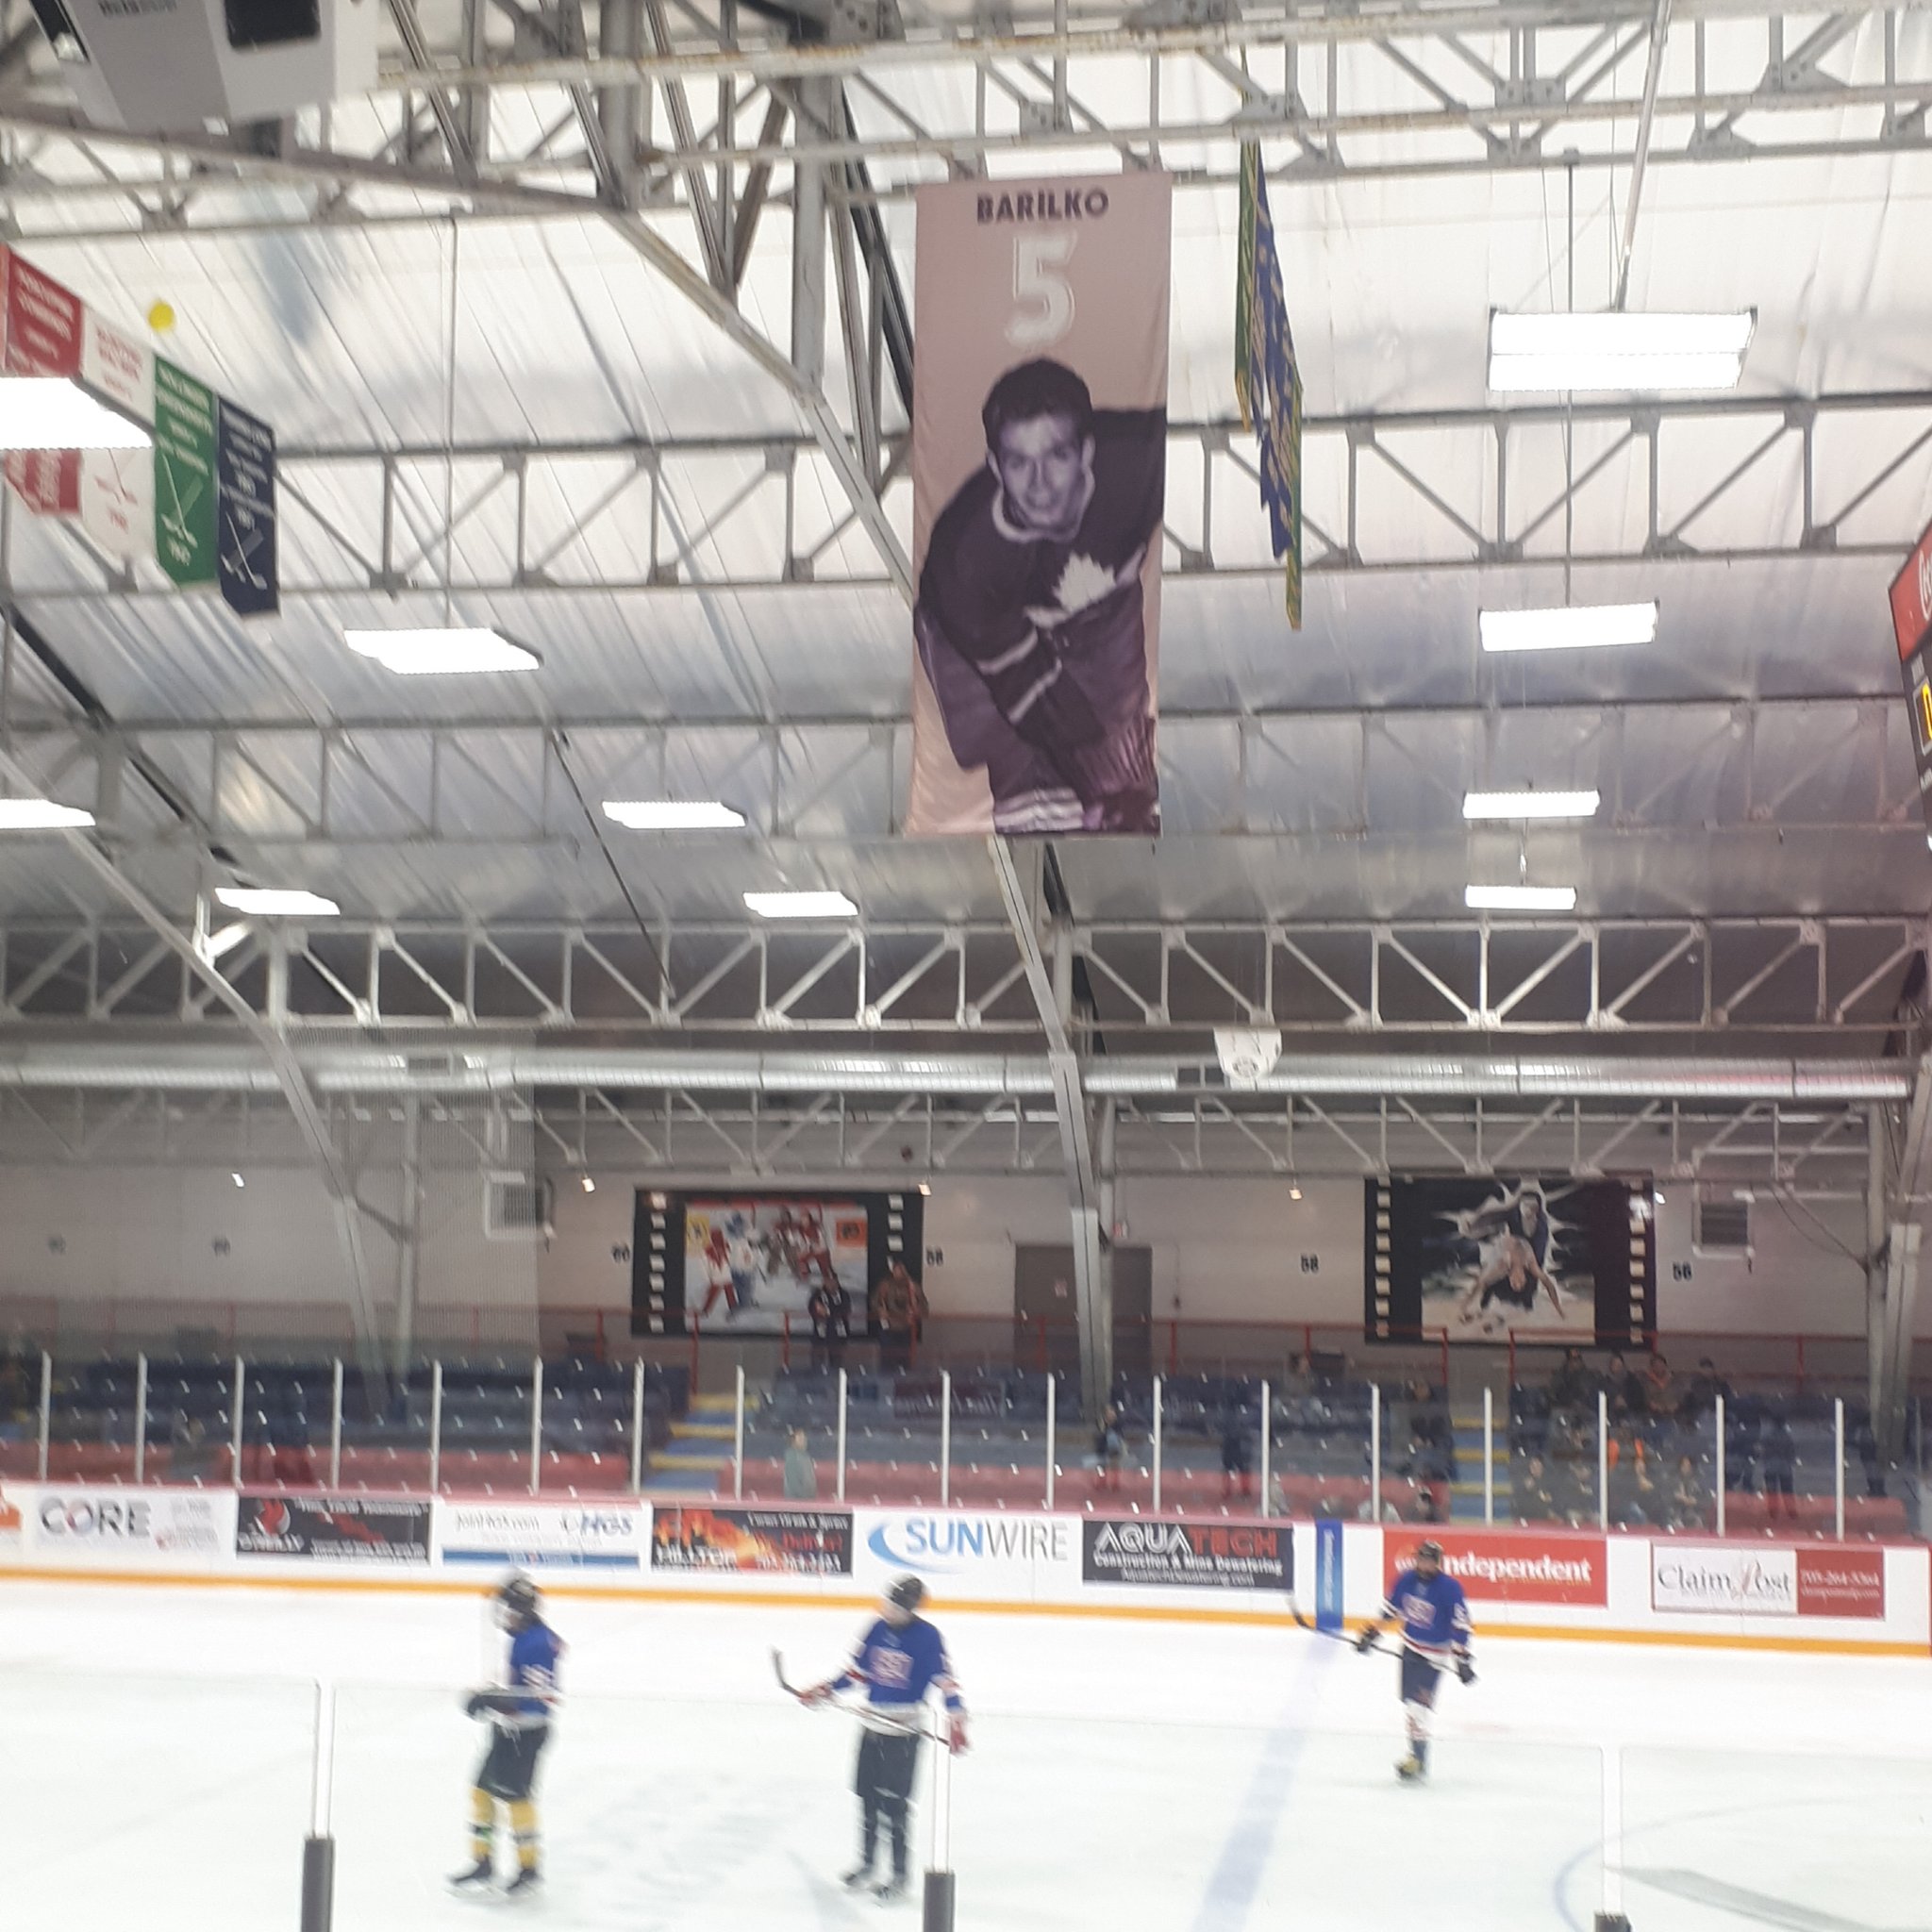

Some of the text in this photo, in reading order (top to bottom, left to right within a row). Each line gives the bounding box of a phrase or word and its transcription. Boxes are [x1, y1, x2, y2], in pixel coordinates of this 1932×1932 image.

[977, 188, 1108, 223] BARILKO
[1005, 232, 1077, 349] 5
[40, 1496, 151, 1538] CORE
[906, 1518, 1068, 1561] SUNWIRE
[1094, 1522, 1277, 1556] AQUATECH
[1442, 1551, 1591, 1583] ndependent
[1657, 1564, 1732, 1591] Claim
